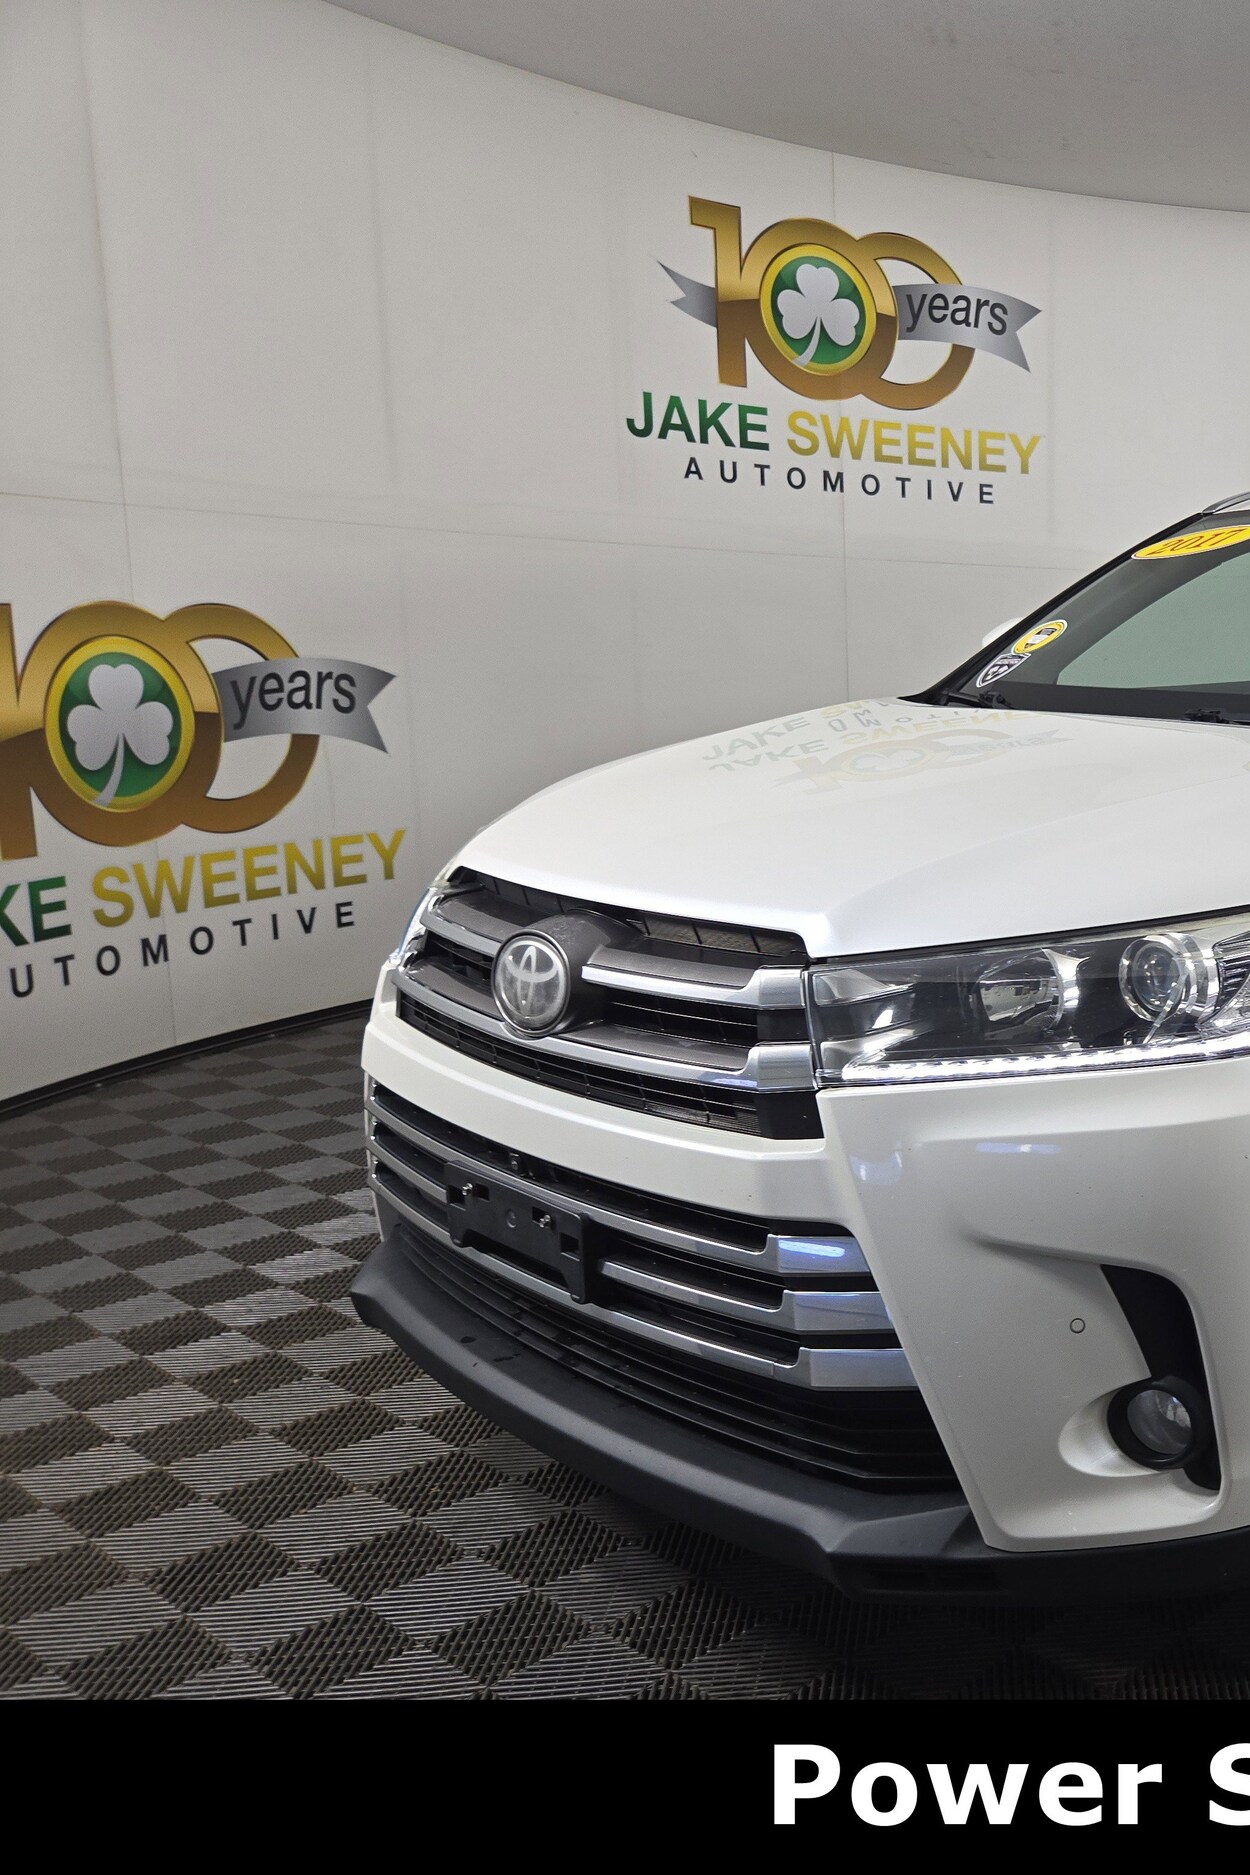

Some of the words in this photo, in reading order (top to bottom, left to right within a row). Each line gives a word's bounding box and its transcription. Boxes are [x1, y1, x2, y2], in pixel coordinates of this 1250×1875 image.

[688, 195, 976, 411] 100
[905, 292, 1009, 336] years
[626, 391, 770, 451] JAKE
[787, 410, 1041, 475] SWEENEY
[684, 457, 995, 504] AUTOMOTIVE
[1146, 527, 1247, 555] 2017
[229, 669, 357, 730] years
[92, 829, 406, 928] SWEENEY
[10, 901, 355, 998] UTOMOTIVE
